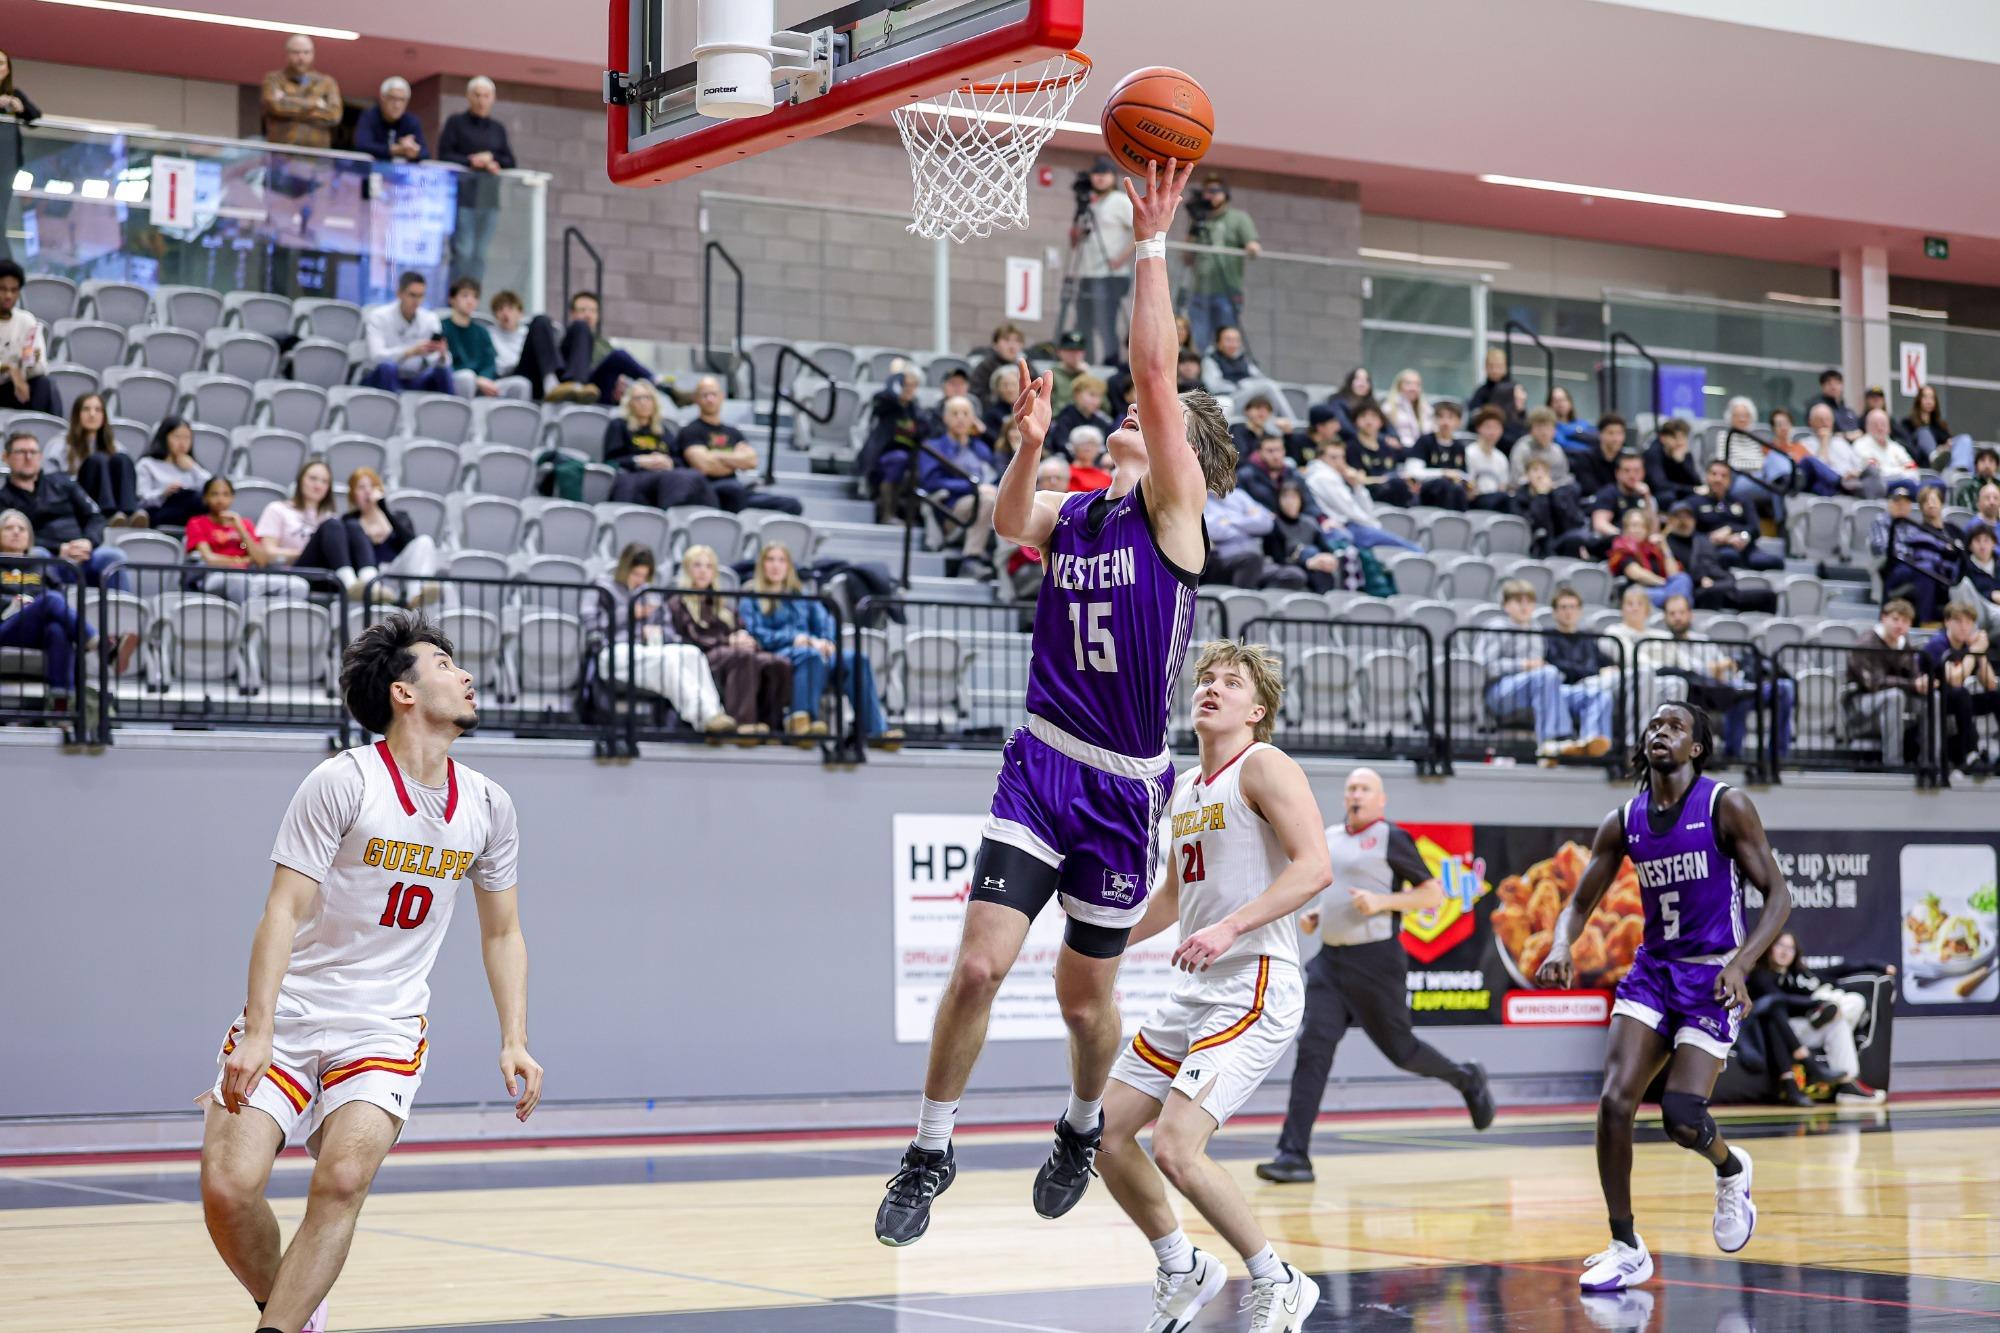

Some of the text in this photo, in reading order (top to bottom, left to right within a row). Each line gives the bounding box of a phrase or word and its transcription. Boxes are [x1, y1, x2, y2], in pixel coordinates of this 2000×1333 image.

[1135, 119, 1202, 151] EVOLUTION
[1017, 271, 1030, 313] J
[1906, 352, 1921, 391] K
[1051, 546, 1136, 591] WESTERN
[1068, 601, 1119, 673] 15
[1172, 802, 1226, 839] UELPH
[362, 837, 474, 881] GUELPH
[910, 844, 980, 882] HP
[1182, 840, 1206, 884] 21
[1797, 853, 1824, 882] up
[1825, 853, 1870, 882] your
[378, 881, 434, 930] 10
[1659, 891, 1680, 941] 5
[1412, 989, 1491, 1011] SUPREME
